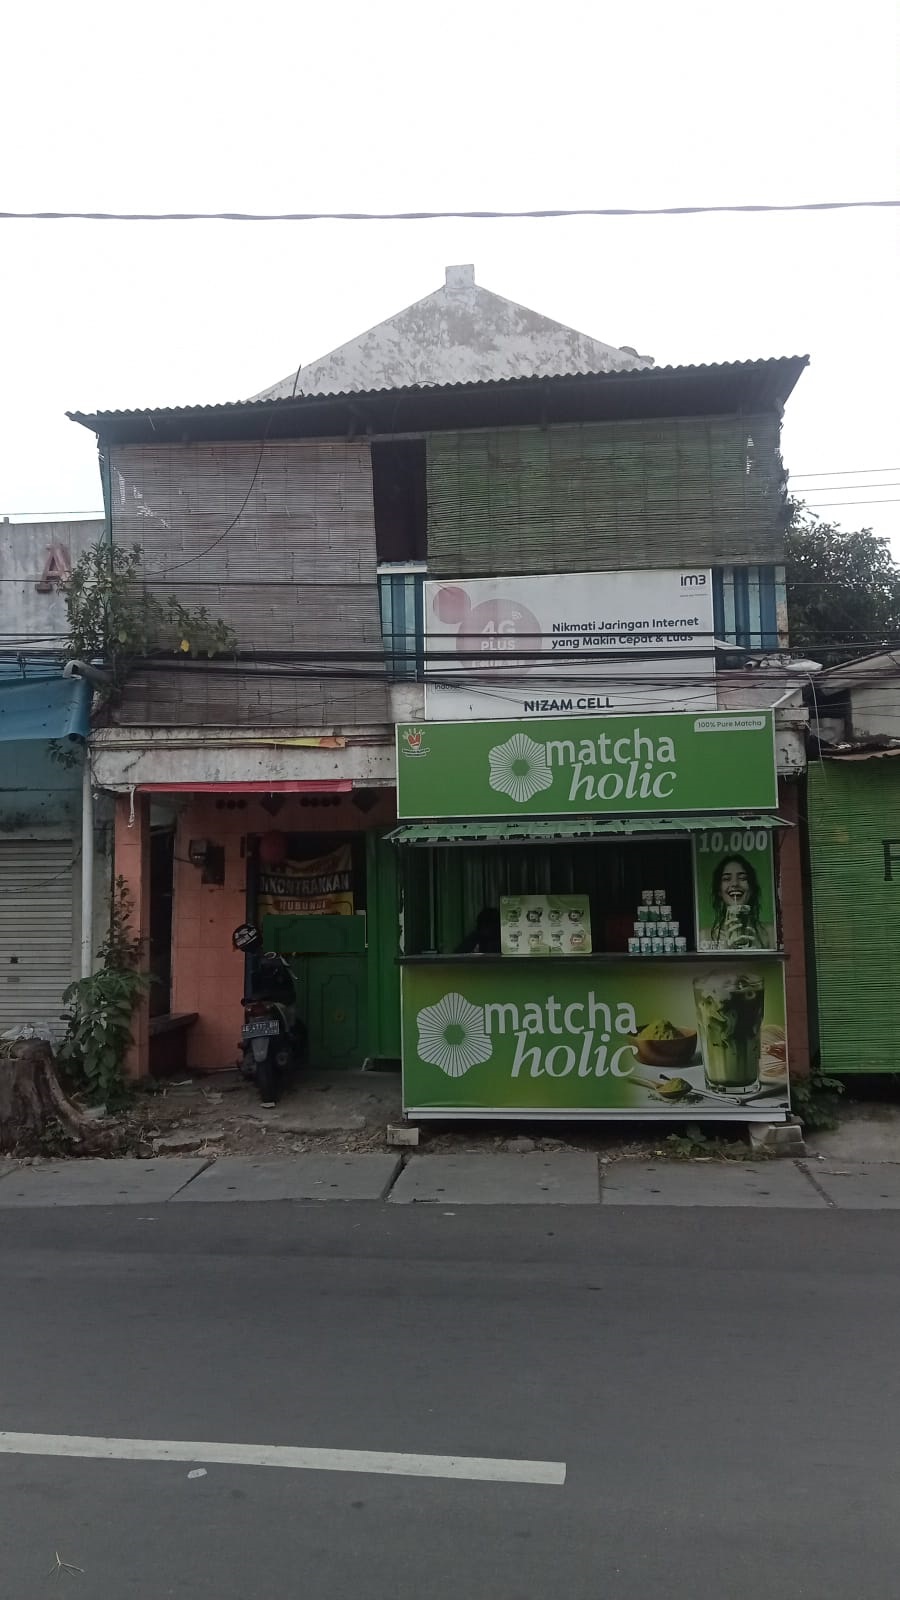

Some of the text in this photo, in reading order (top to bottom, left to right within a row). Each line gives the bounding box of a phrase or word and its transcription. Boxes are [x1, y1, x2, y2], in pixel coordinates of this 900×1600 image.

[552, 617, 699, 633] Nikmati Jaringan Internet
[481, 639, 516, 651] PLUS
[551, 637, 580, 649] yang
[583, 636, 616, 646] Makin
[618, 635, 653, 647] Cepat
[654, 635, 664, 643] &
[523, 697, 614, 712] NIZAM CELL
[698, 721, 715, 729] 100%
[734, 720, 762, 728] Matcha
[545, 728, 676, 767] matcha
[568, 760, 677, 801] holic
[699, 831, 768, 853] 10.000
[485, 991, 637, 1036] matcha
[510, 1030, 639, 1078] holic
